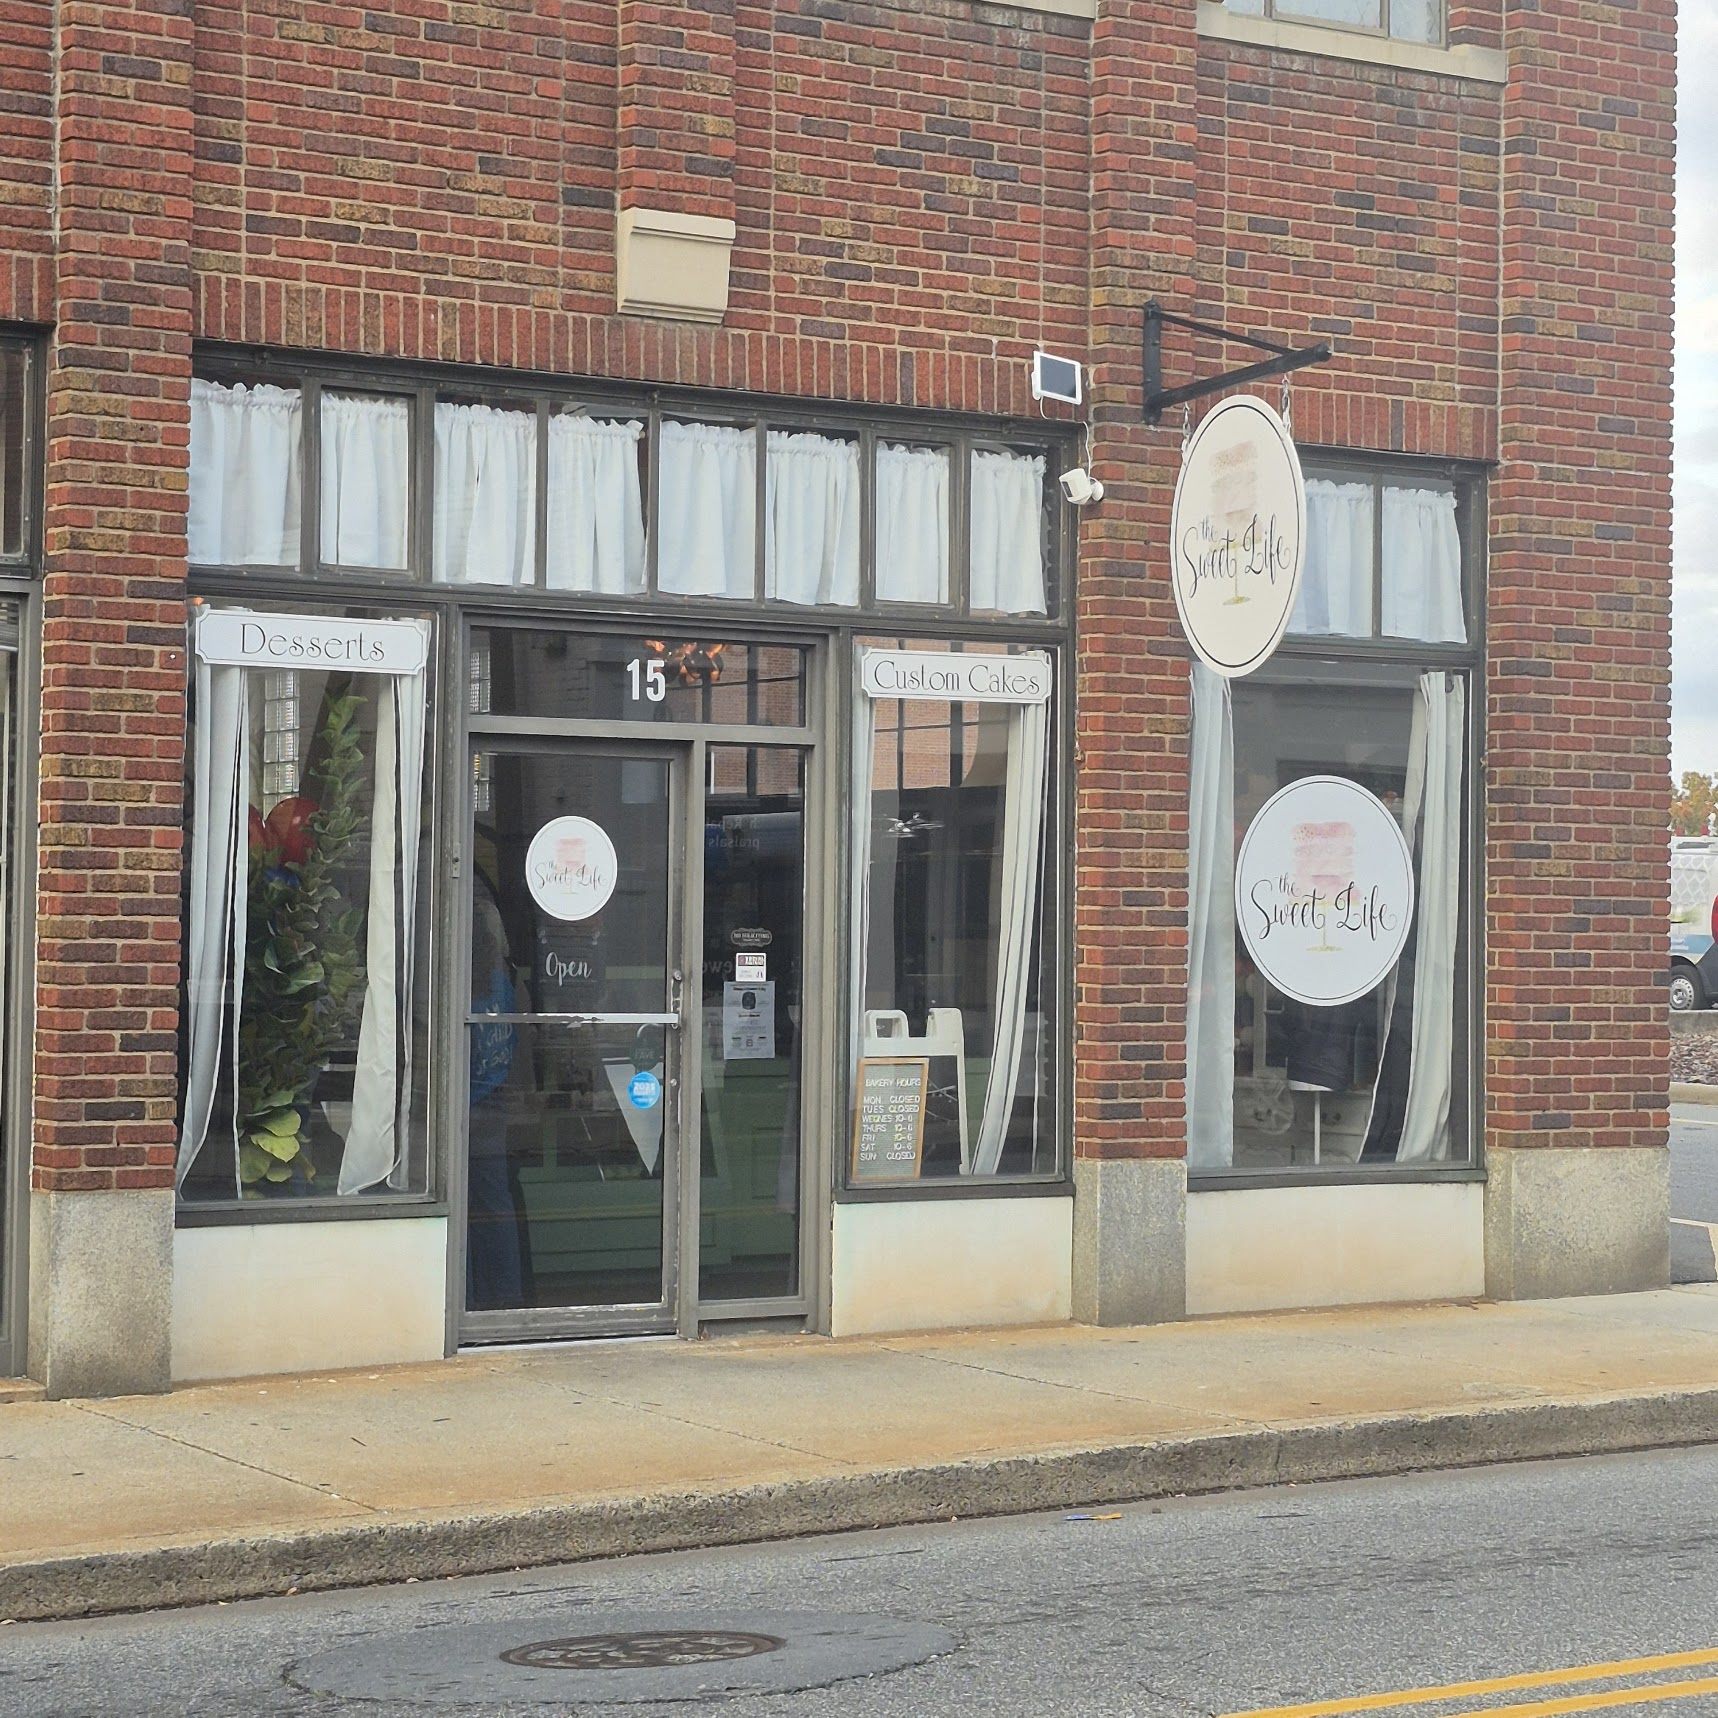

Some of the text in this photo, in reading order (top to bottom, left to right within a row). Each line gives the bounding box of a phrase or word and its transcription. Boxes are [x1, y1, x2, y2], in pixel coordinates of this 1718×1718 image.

[1200, 514, 1218, 542] the
[1182, 513, 1291, 598] Sweet Life
[239, 622, 386, 662] Desserts
[625, 658, 667, 702] 15
[873, 660, 1040, 694] Custom Cakes
[534, 862, 607, 891] Sweet Life
[1274, 871, 1300, 898] the
[1250, 879, 1398, 942] Sweet Life
[545, 951, 593, 987] Open
[865, 1078, 894, 1087] BAKERY
[863, 1095, 920, 1105] MON CLOSED
[863, 1104, 920, 1114] TUES CLOSED
[860, 1143, 876, 1152] SAT
[862, 1133, 876, 1142] FRI
[859, 1151, 916, 1161] SUN CLOSED
